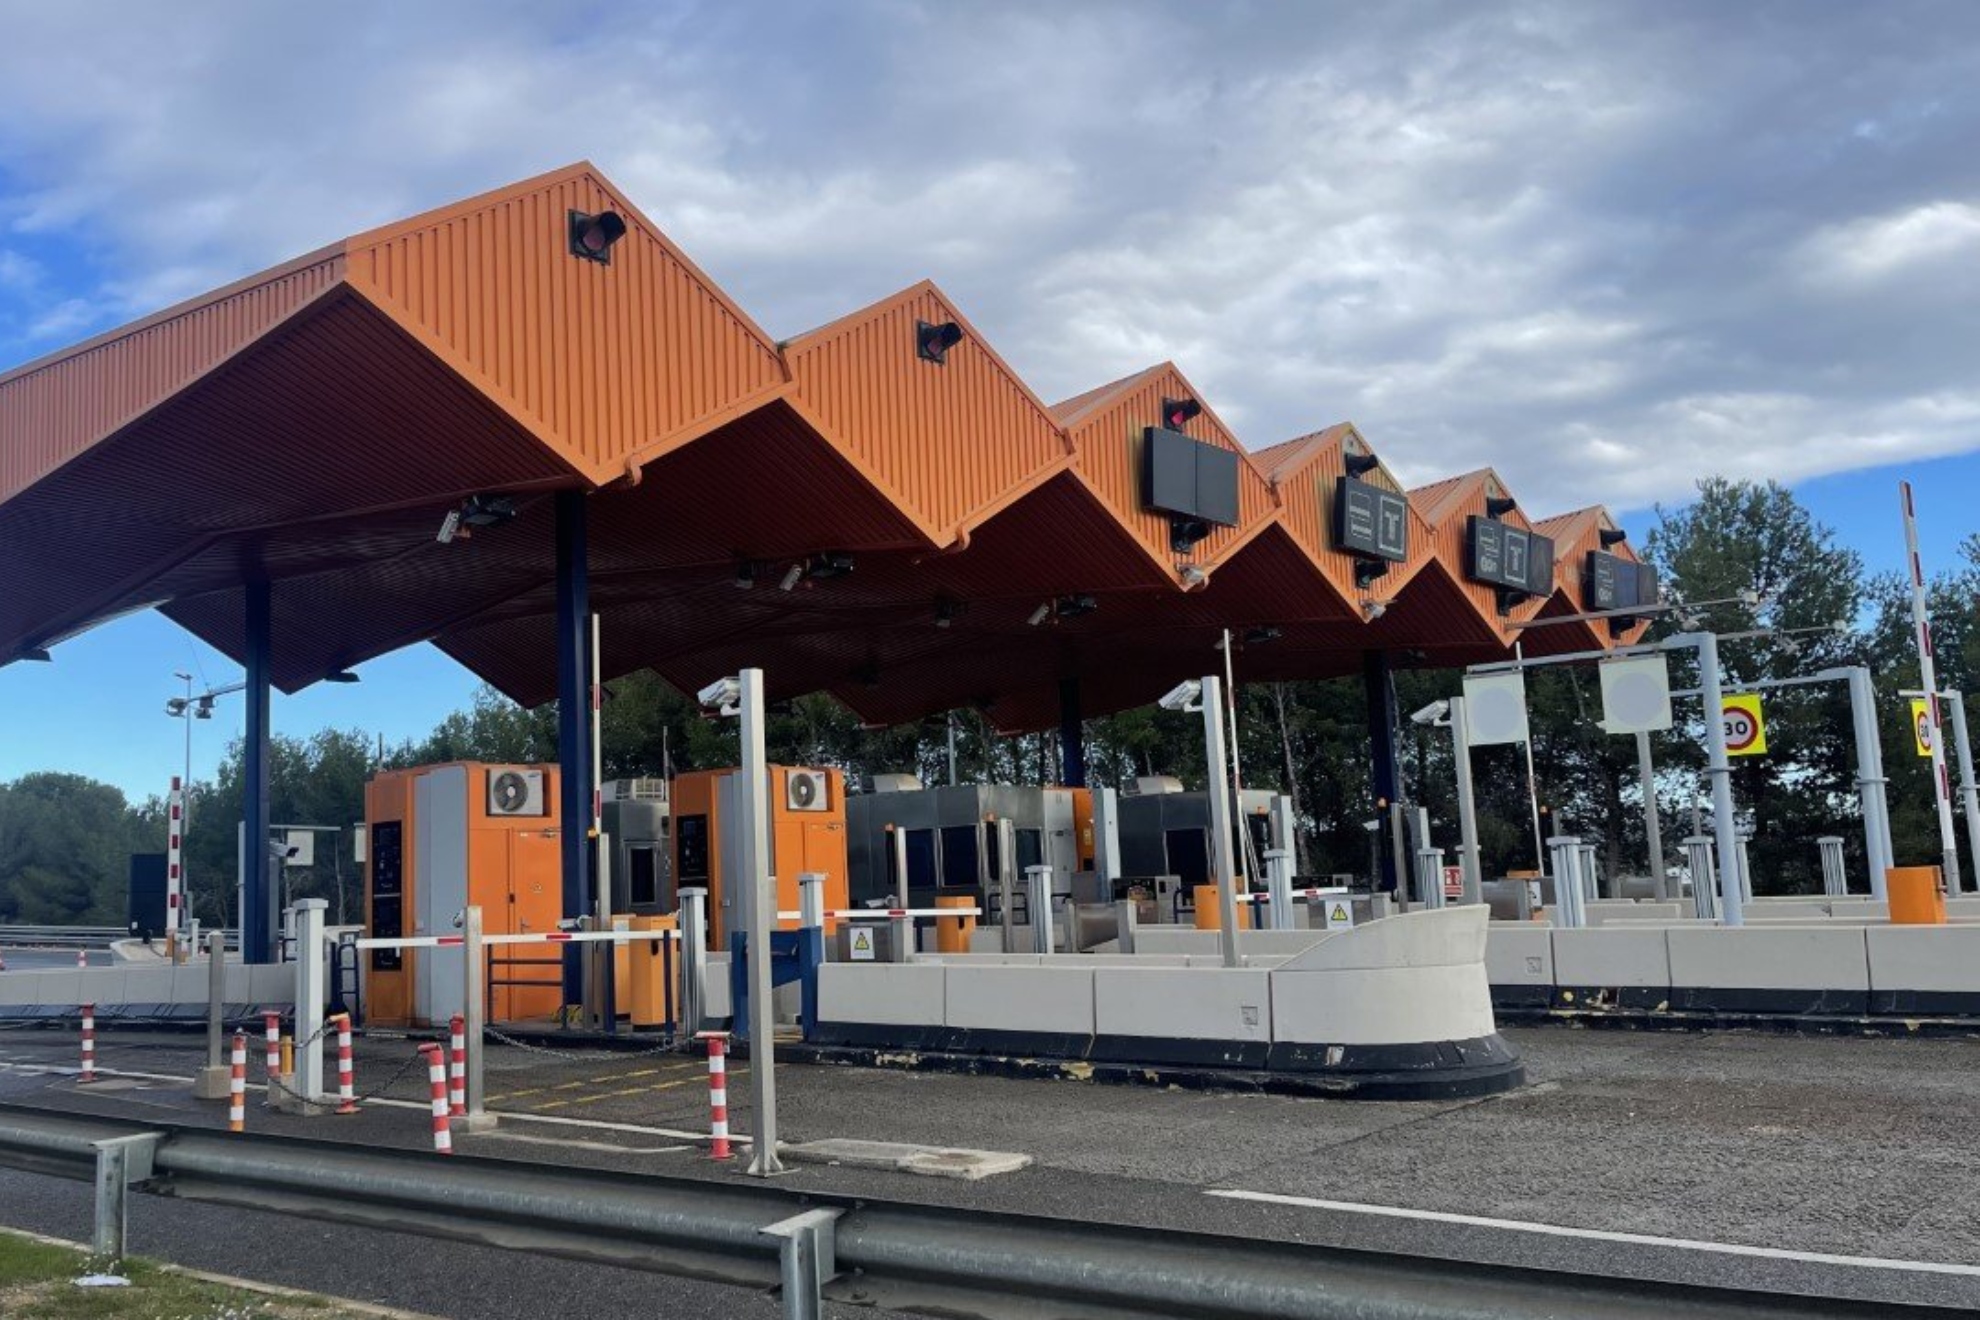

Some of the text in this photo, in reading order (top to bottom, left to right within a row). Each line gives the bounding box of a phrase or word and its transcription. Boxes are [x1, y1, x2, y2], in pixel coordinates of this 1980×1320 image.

[1385, 511, 1400, 540] T
[1510, 545, 1522, 571] T
[1723, 721, 1748, 736] 30
